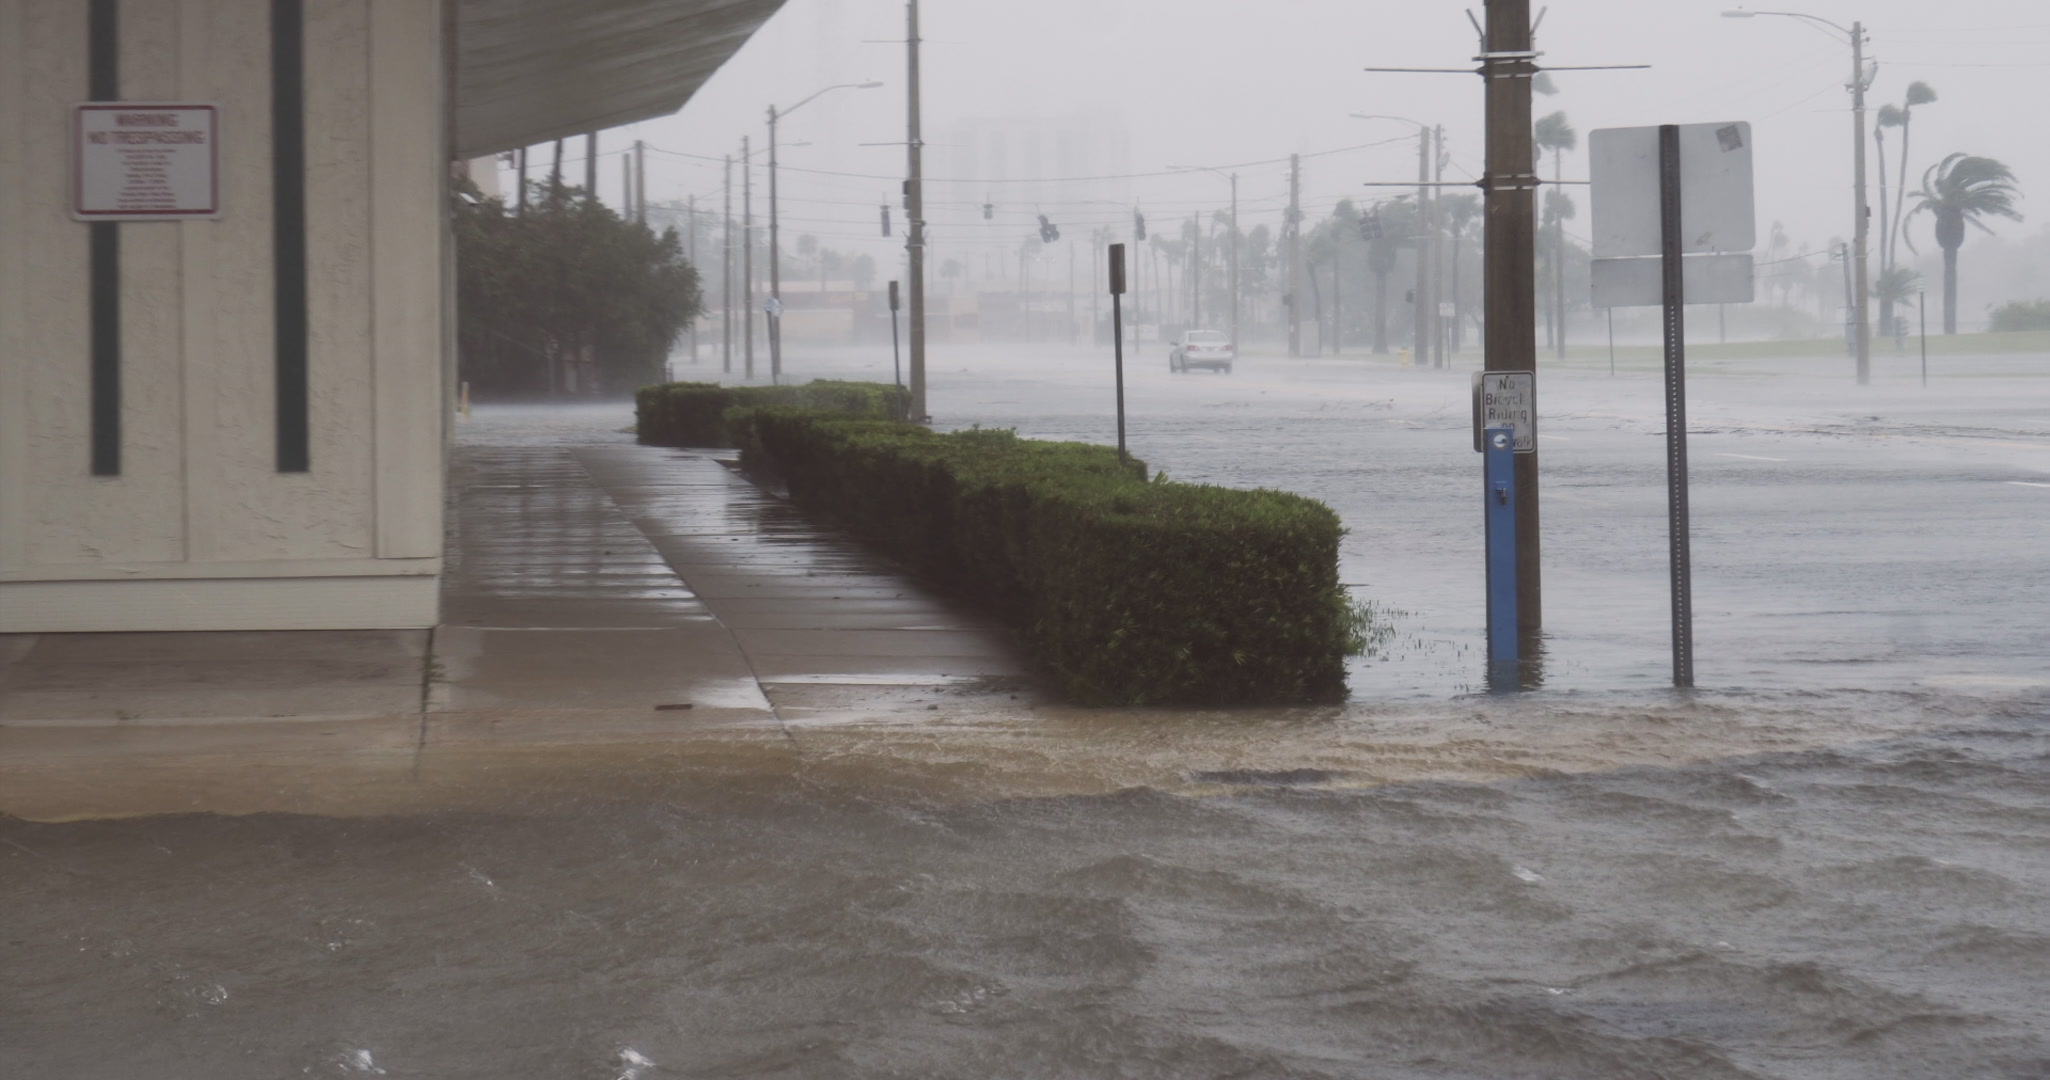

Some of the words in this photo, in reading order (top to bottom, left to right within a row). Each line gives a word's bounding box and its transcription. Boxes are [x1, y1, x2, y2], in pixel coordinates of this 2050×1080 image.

[116, 113, 178, 127] WARNING
[88, 131, 107, 144] NO
[110, 131, 205, 144] TRESPASSING
[1499, 378, 1515, 390] No
[1485, 393, 1528, 406] Bicycl
